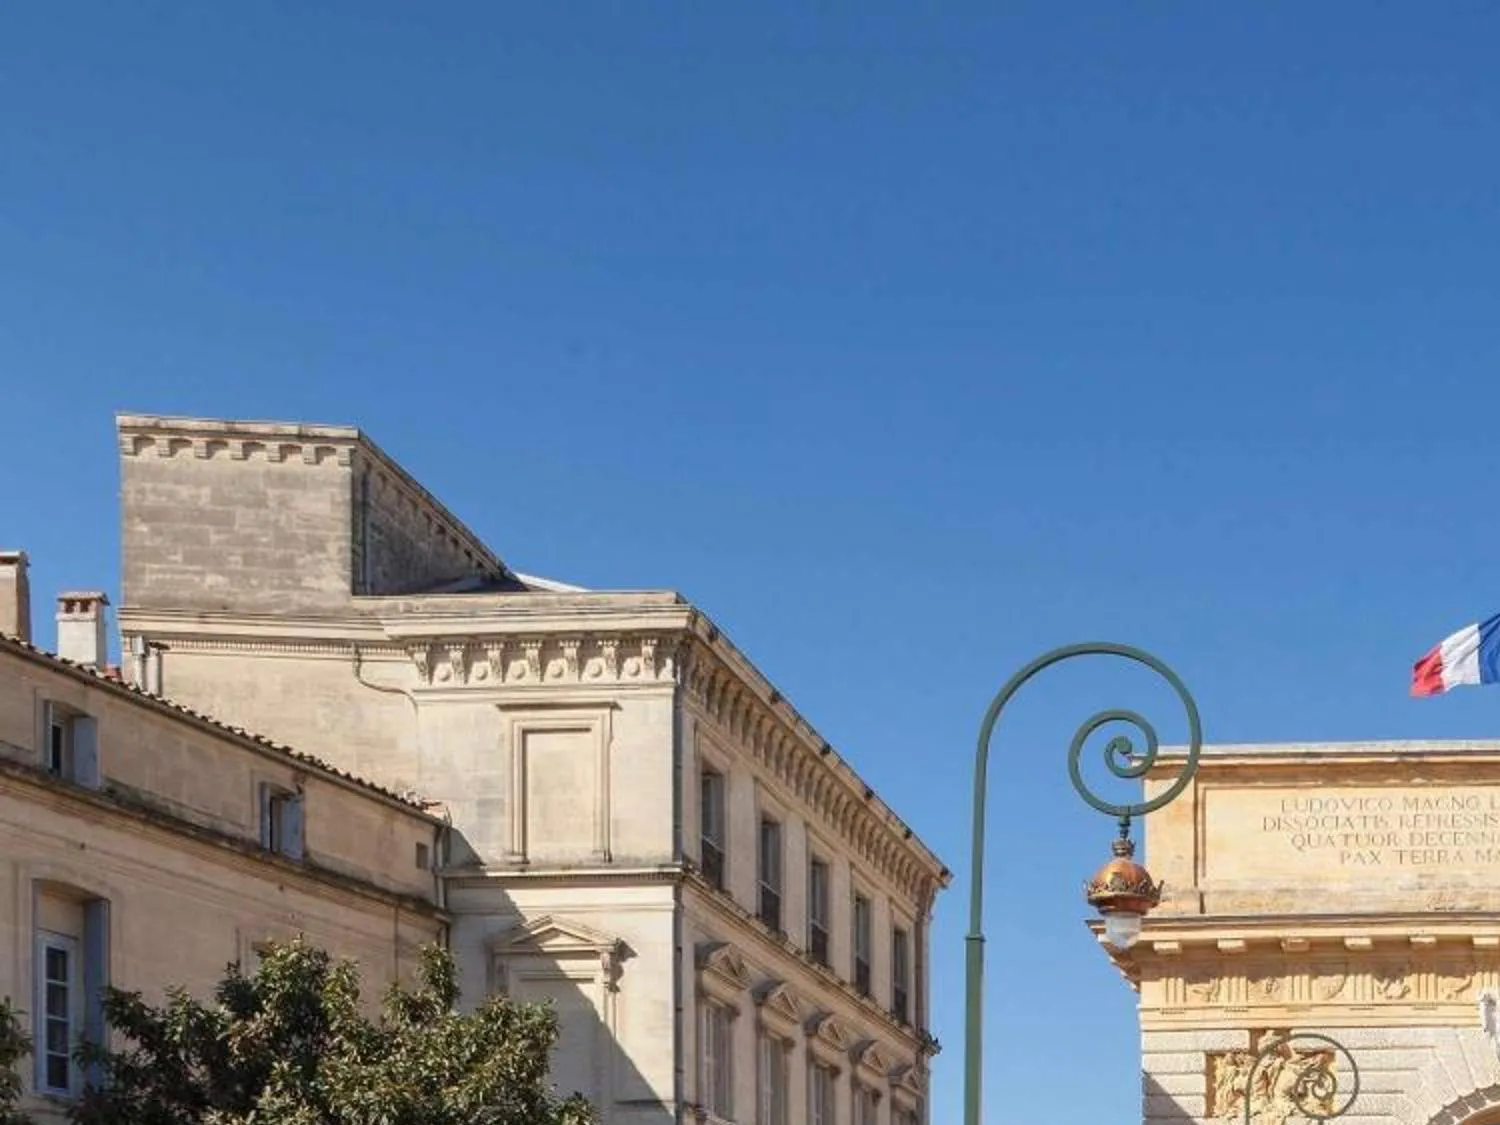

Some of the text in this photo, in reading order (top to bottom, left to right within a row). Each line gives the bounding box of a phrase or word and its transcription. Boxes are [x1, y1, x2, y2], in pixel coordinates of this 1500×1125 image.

[1280, 797, 1393, 813] LUDOVICO
[1402, 795, 1481, 812] MAGNO
[1291, 832, 1399, 852] QUATUOR
[1340, 850, 1382, 865] PAX
[1392, 849, 1465, 865] TERRA
